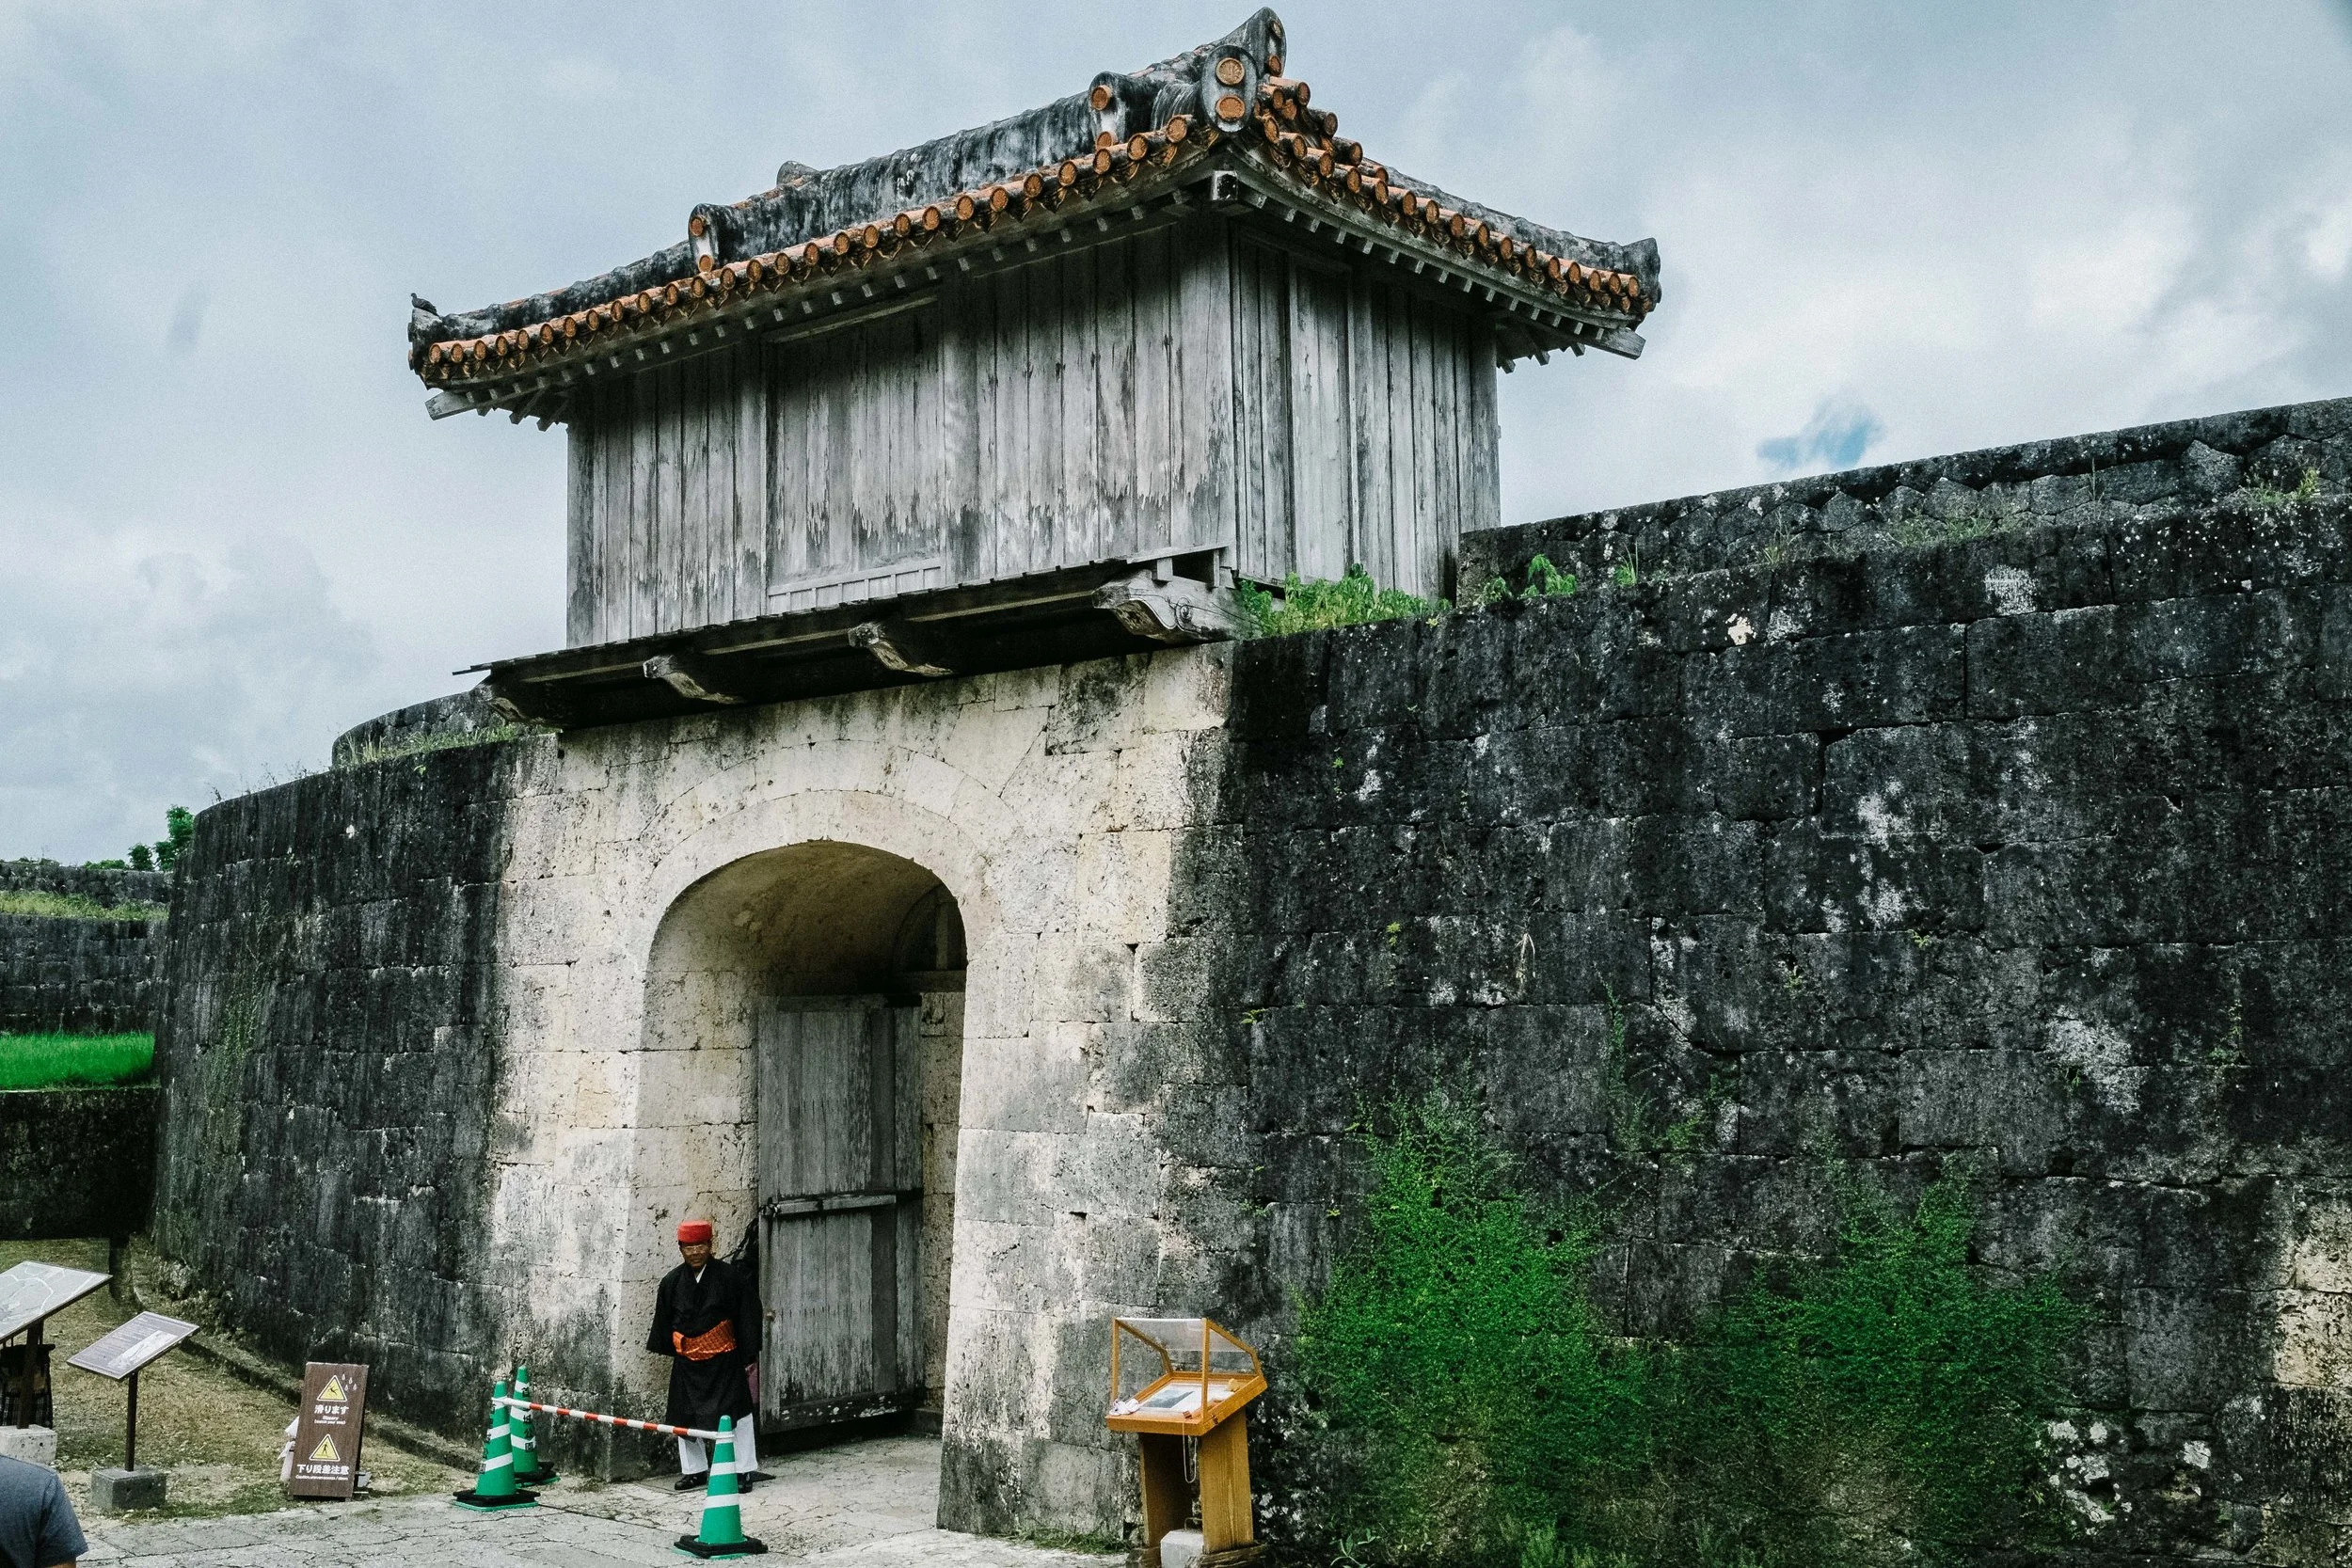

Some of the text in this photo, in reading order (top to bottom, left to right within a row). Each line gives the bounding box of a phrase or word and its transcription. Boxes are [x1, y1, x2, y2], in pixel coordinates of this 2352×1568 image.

[296, 1464, 349, 1475] 下り段差注意
